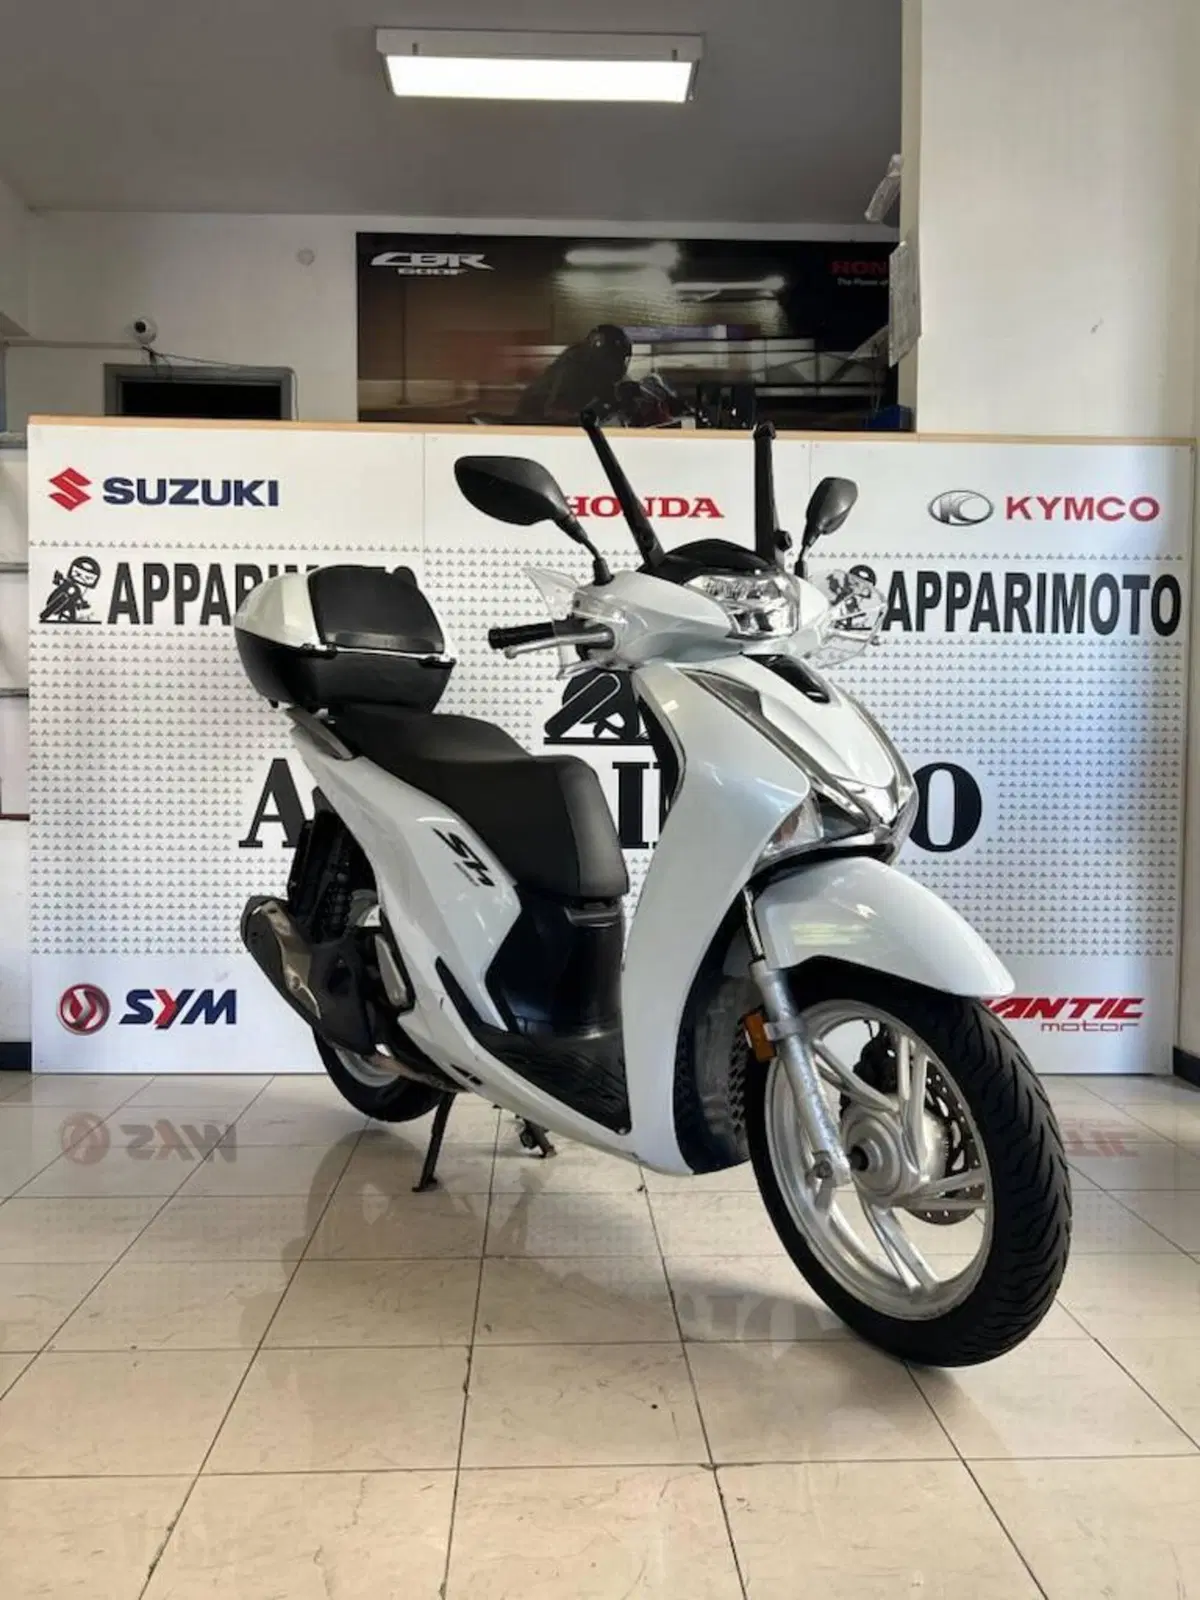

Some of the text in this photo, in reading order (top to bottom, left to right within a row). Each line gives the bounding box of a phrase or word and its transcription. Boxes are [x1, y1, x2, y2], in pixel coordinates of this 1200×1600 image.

[371, 251, 494, 270] CBR
[831, 261, 888, 276] HON
[102, 476, 279, 507] SUZUKI
[1006, 495, 1160, 522] KYMCO
[881, 570, 1182, 637] APPARIMOTO
[118, 988, 237, 1030] SYM
[983, 997, 1145, 1019] ANTIC
[1040, 1020, 1139, 1033] motor
